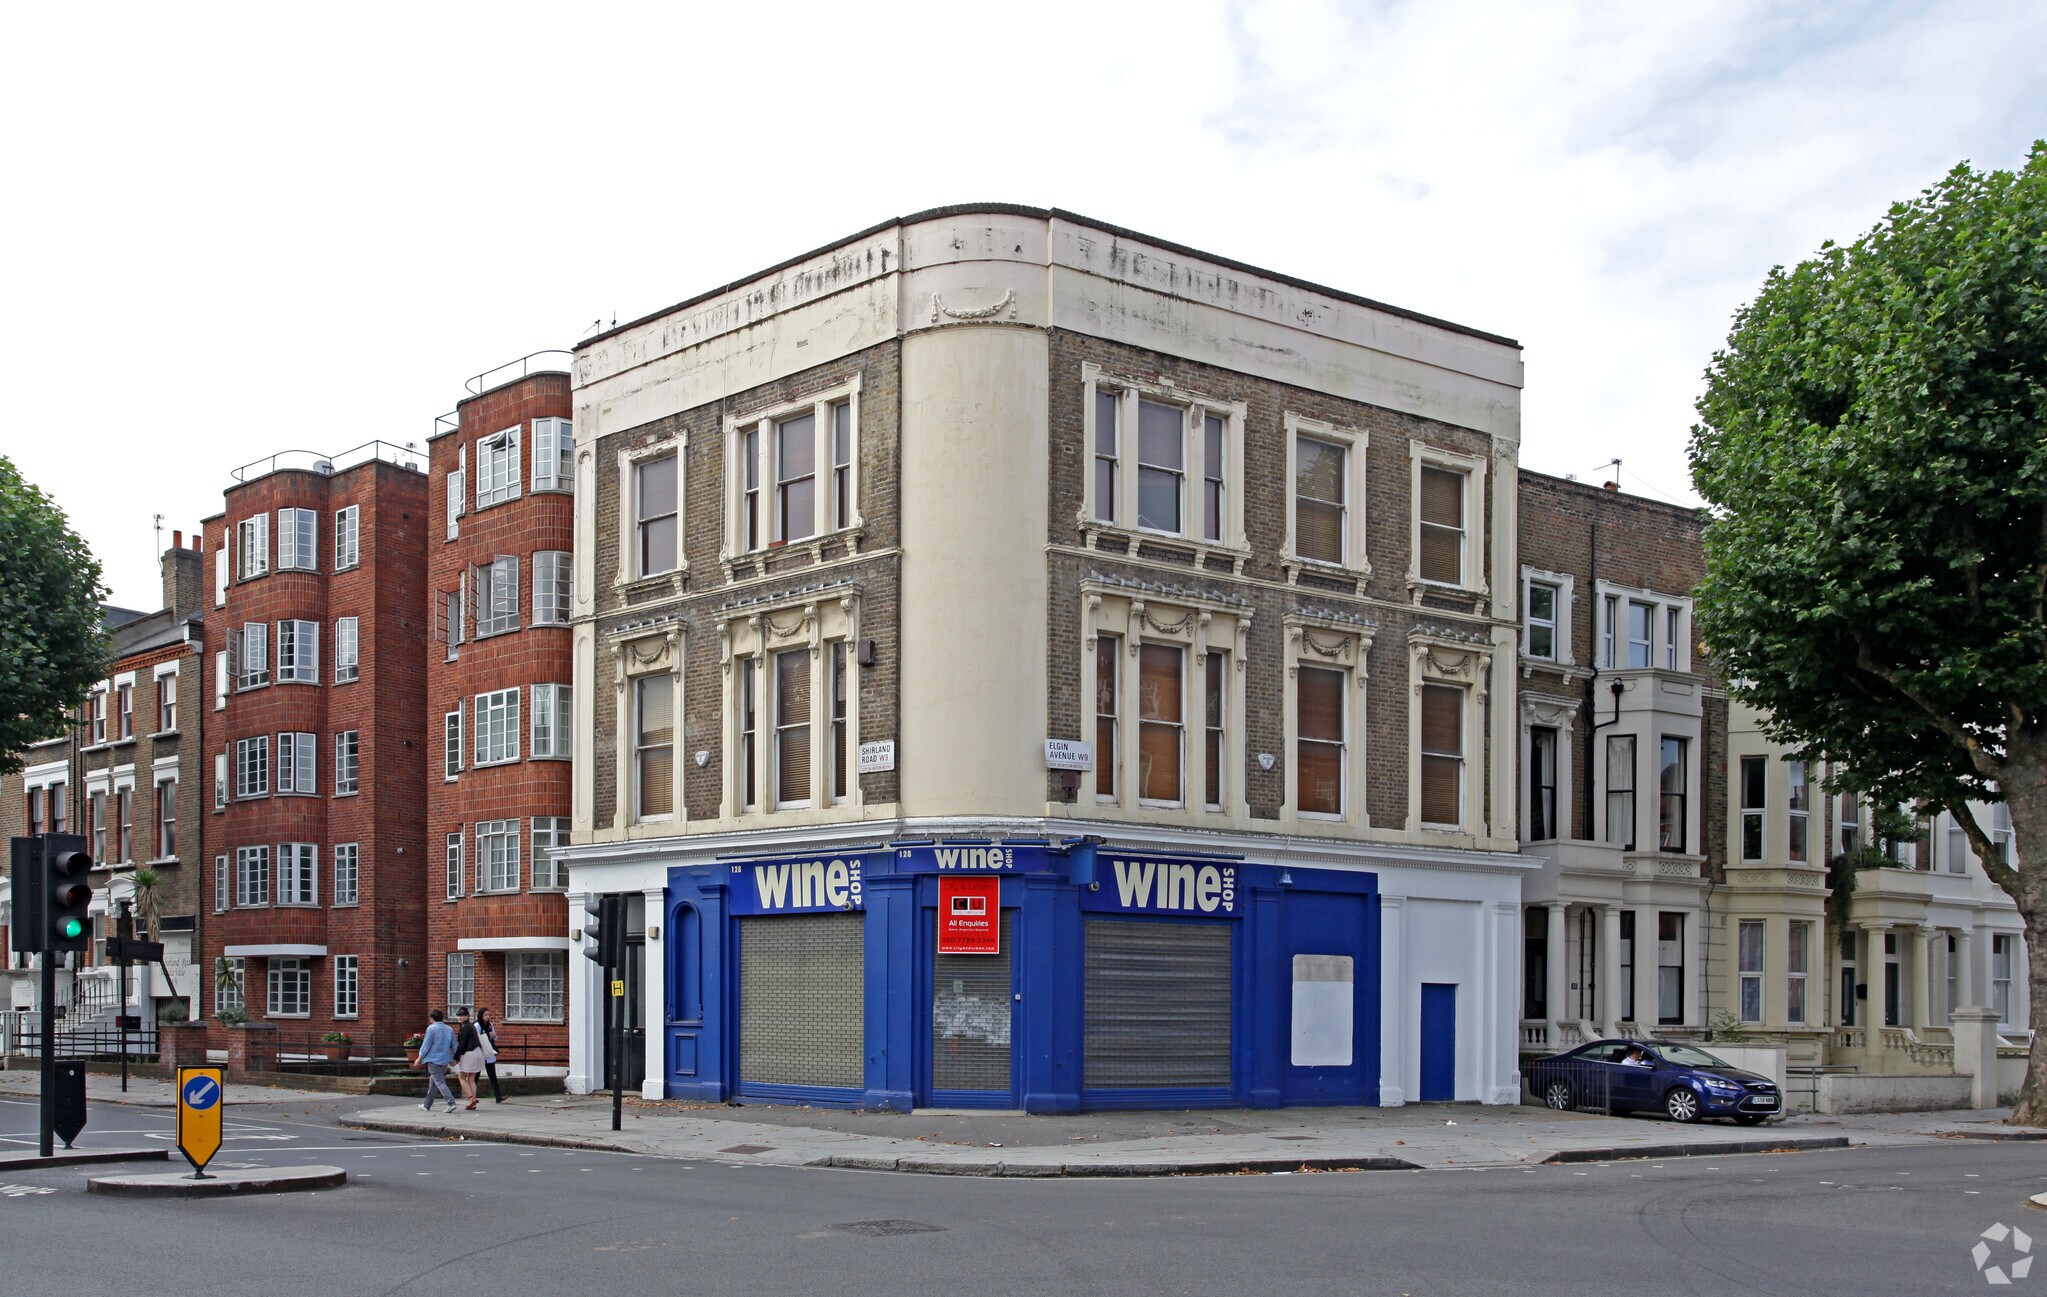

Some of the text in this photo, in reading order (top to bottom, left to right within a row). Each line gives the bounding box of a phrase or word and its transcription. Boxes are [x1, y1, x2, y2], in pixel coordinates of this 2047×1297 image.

[861, 744, 891, 756] SHIRLAND
[1049, 741, 1069, 751] ELGIN
[861, 754, 889, 764] ROAD W9
[1049, 751, 1089, 762] AVENUE W9
[899, 850, 912, 858] 128
[1005, 848, 1013, 868] SHOP
[731, 865, 742, 873] 128
[850, 859, 861, 905] SHOP
[944, 882, 958, 891] City
[968, 881, 993, 890] Urban
[1222, 868, 1234, 912] SHOP
[958, 919, 989, 927] Enquiries
[613, 982, 622, 994] H
